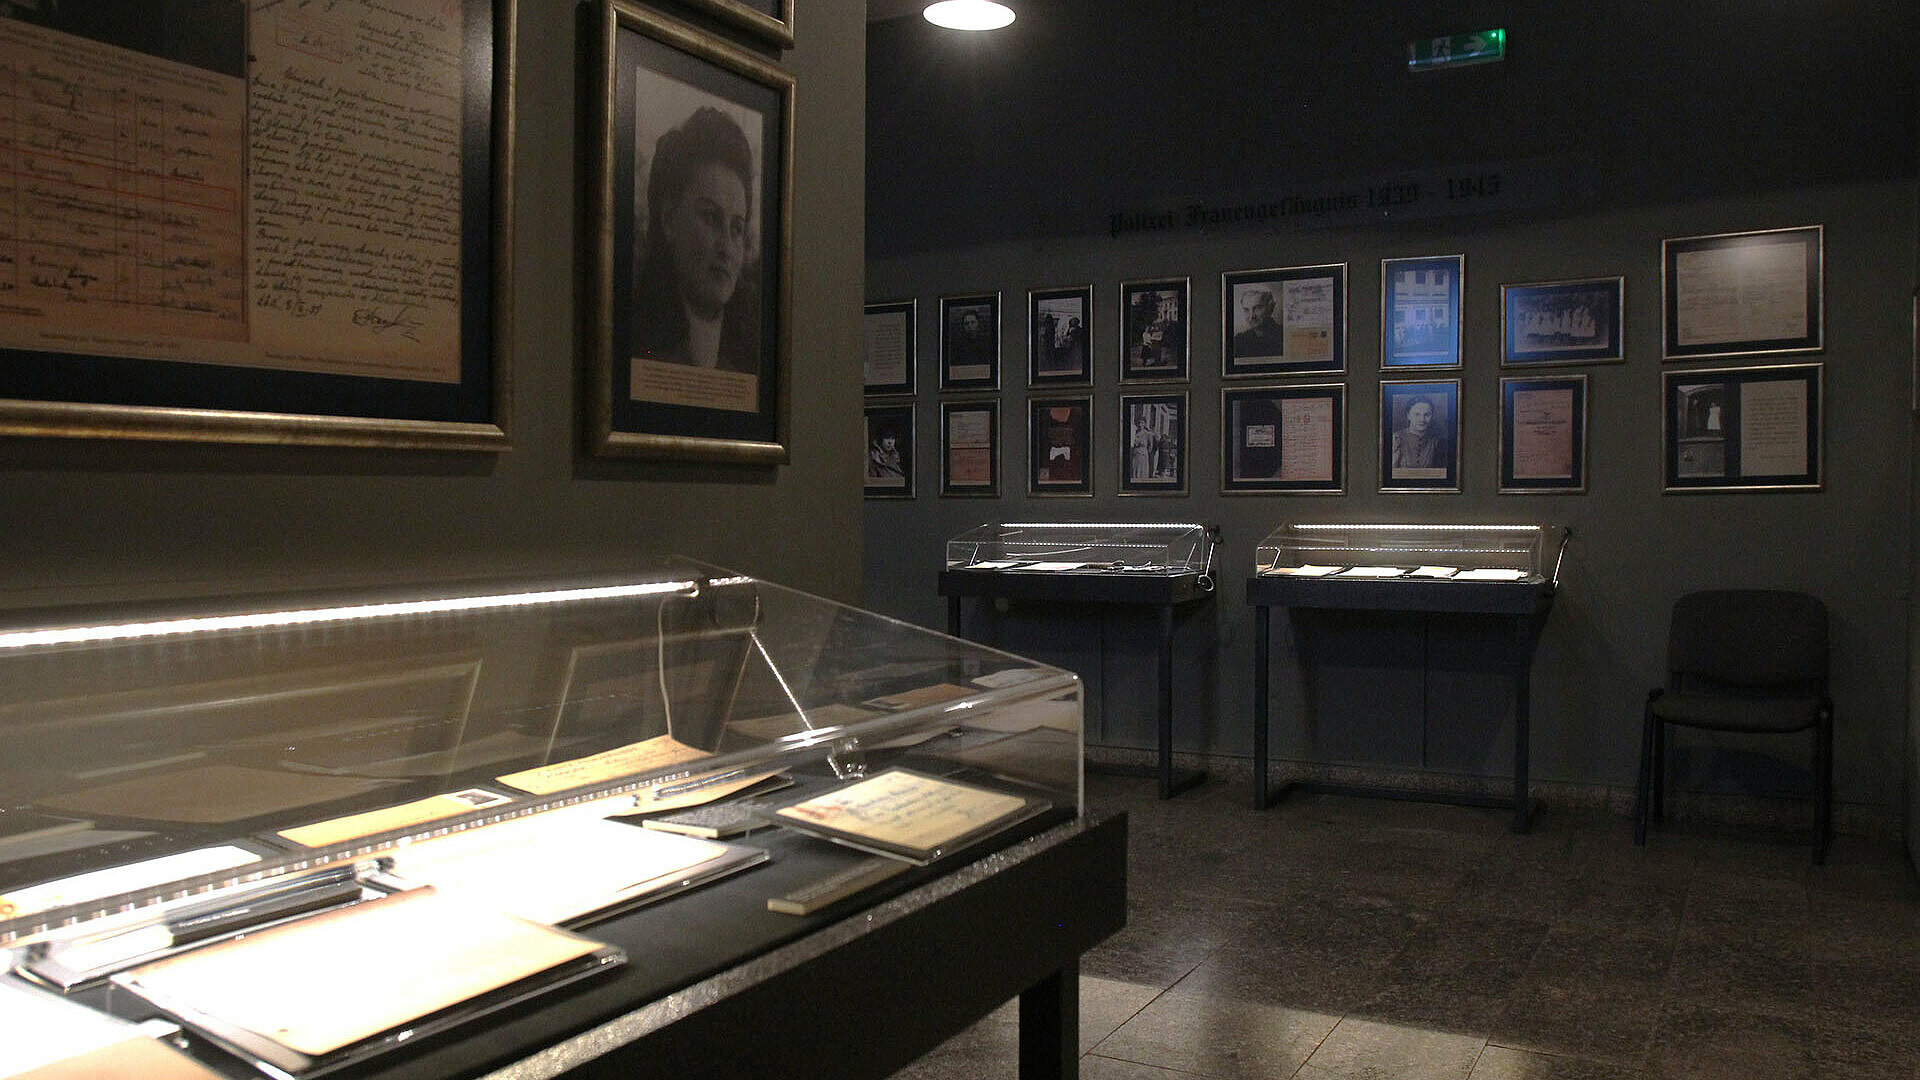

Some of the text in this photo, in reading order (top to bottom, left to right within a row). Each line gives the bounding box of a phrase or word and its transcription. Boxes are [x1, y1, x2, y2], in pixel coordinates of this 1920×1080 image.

[1110, 211, 1174, 238] Polizei
[1368, 183, 1418, 208] 1939
[1447, 174, 1501, 200] 1945
